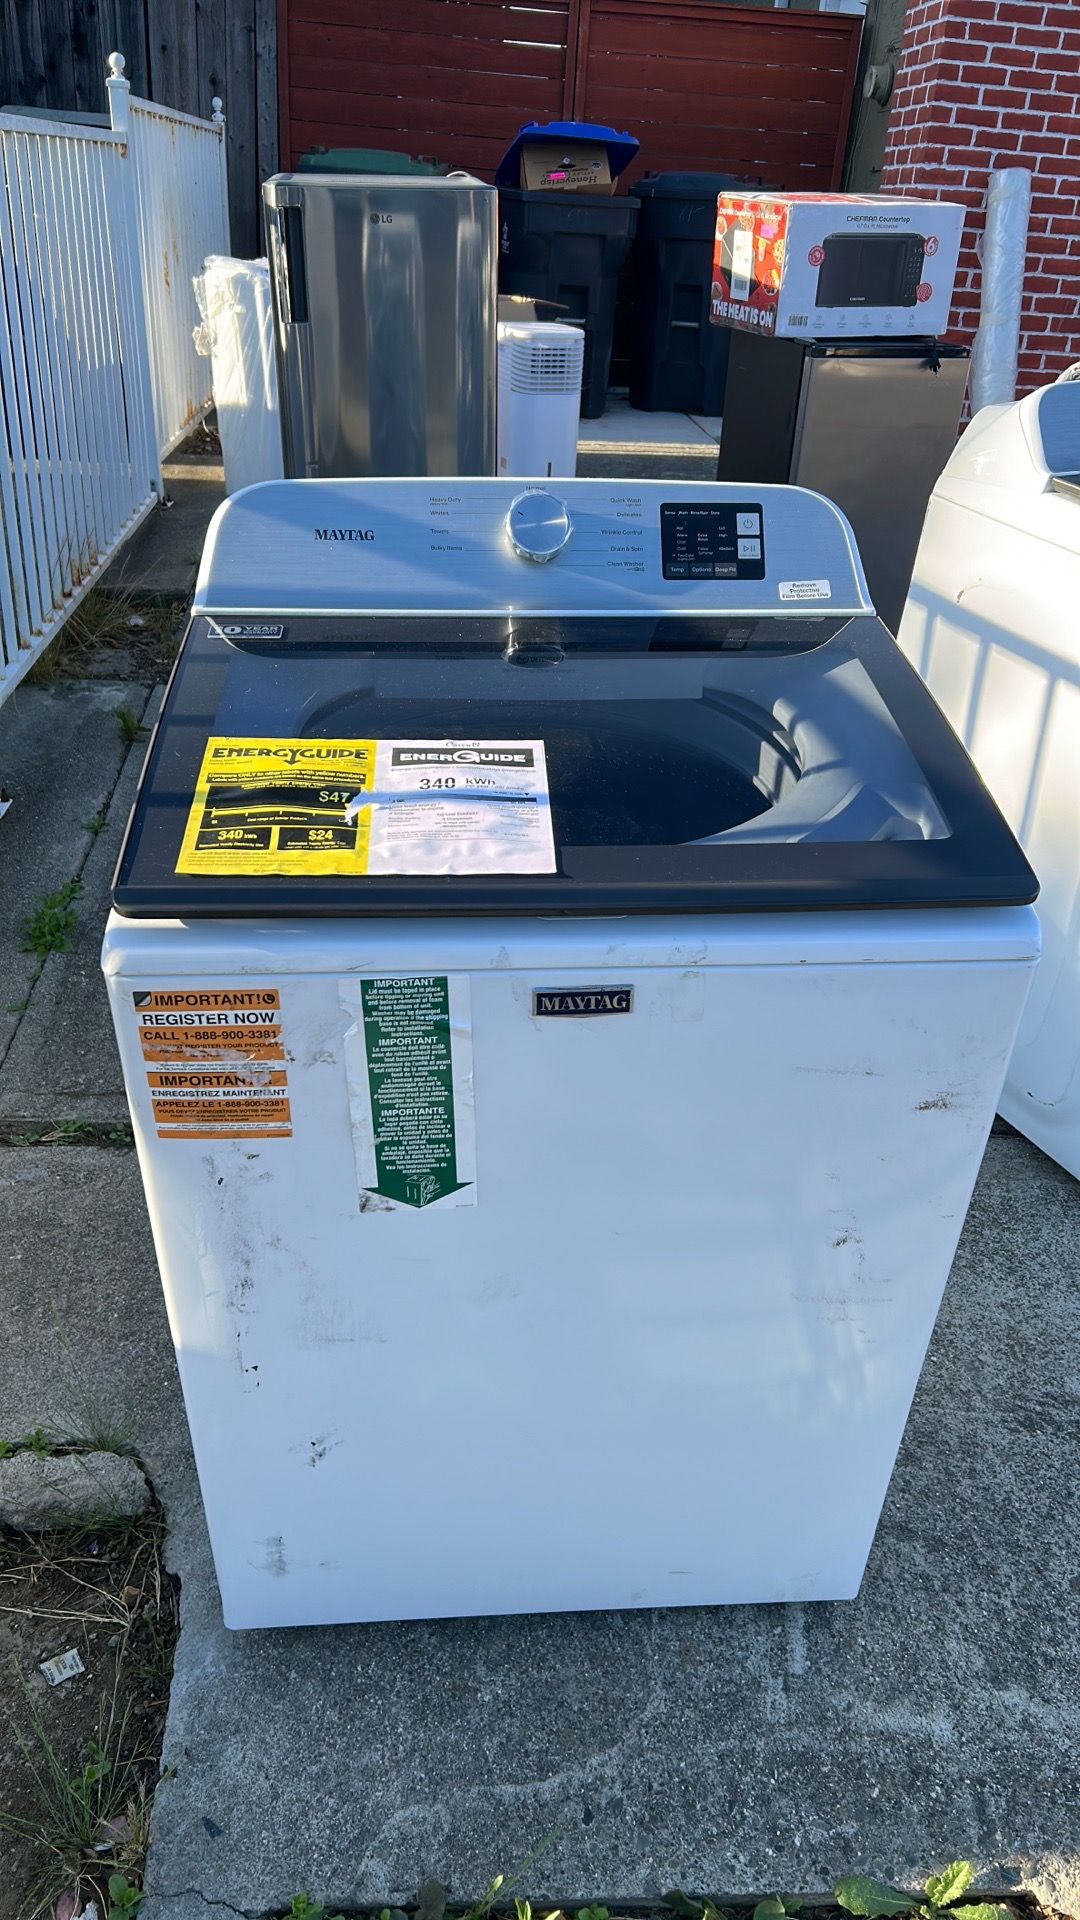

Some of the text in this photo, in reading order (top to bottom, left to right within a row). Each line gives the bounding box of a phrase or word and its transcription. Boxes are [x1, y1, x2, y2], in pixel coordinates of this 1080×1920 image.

[540, 176, 597, 185] Honeycrisp
[381, 215, 393, 224] LG
[713, 300, 773, 327] THE HEAT IS ON
[314, 528, 375, 541] MAYTAG
[212, 748, 368, 762] ENERGYGUIDE
[400, 750, 526, 763] ENERGUIDE
[420, 778, 455, 789] 340
[465, 778, 496, 786] kWh
[218, 829, 243, 840] 340
[309, 829, 333, 840] $24
[374, 978, 435, 987] IMPORTANT
[155, 994, 260, 1006] IMPORTANT!
[541, 994, 627, 1011] MAYTAG
[143, 1013, 274, 1025] REGISTER NOW
[144, 1030, 277, 1040] CALL 1-888-900-3381
[379, 1037, 437, 1046] IMPORTANT
[160, 1076, 254, 1086] IMPORTAN
[381, 1107, 445, 1116] IMPORTANTE
